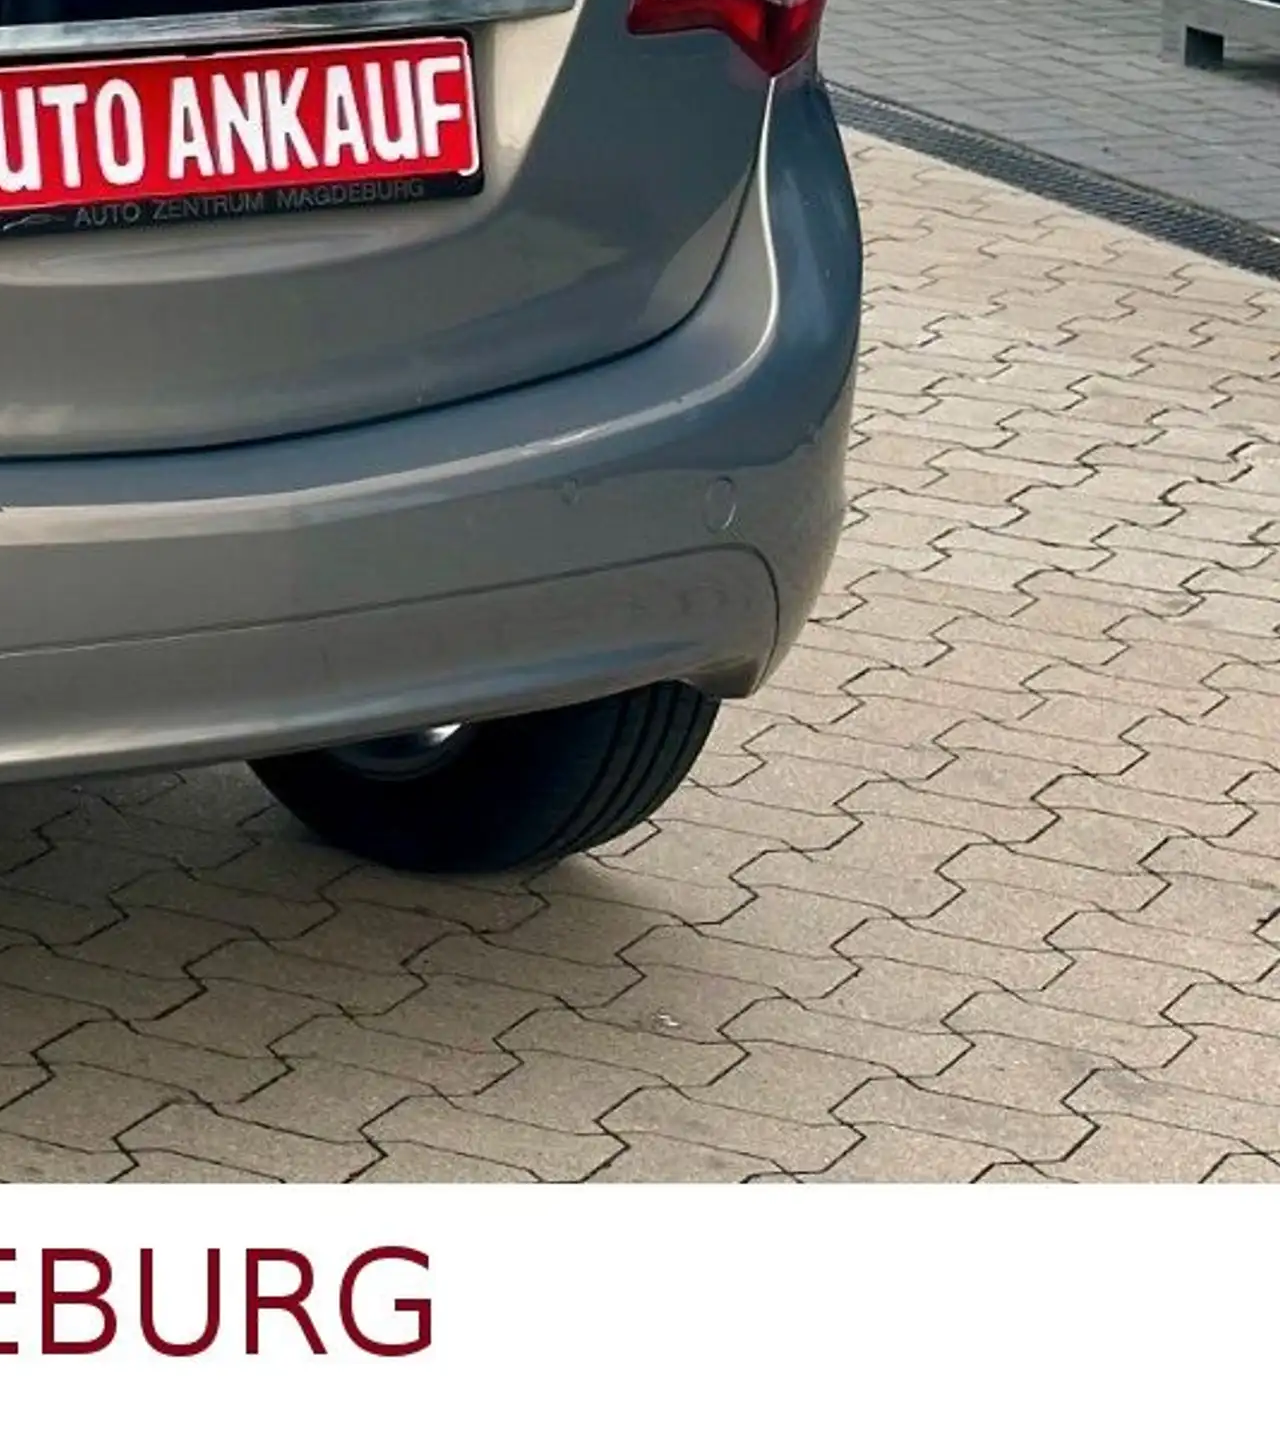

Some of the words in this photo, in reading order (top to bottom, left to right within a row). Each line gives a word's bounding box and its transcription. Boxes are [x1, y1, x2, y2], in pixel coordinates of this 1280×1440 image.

[168, 55, 462, 180] ANKAUF
[73, 204, 140, 228] AUTO
[152, 192, 265, 221] ZENTRUM
[276, 178, 425, 210] MAGDEBURG
